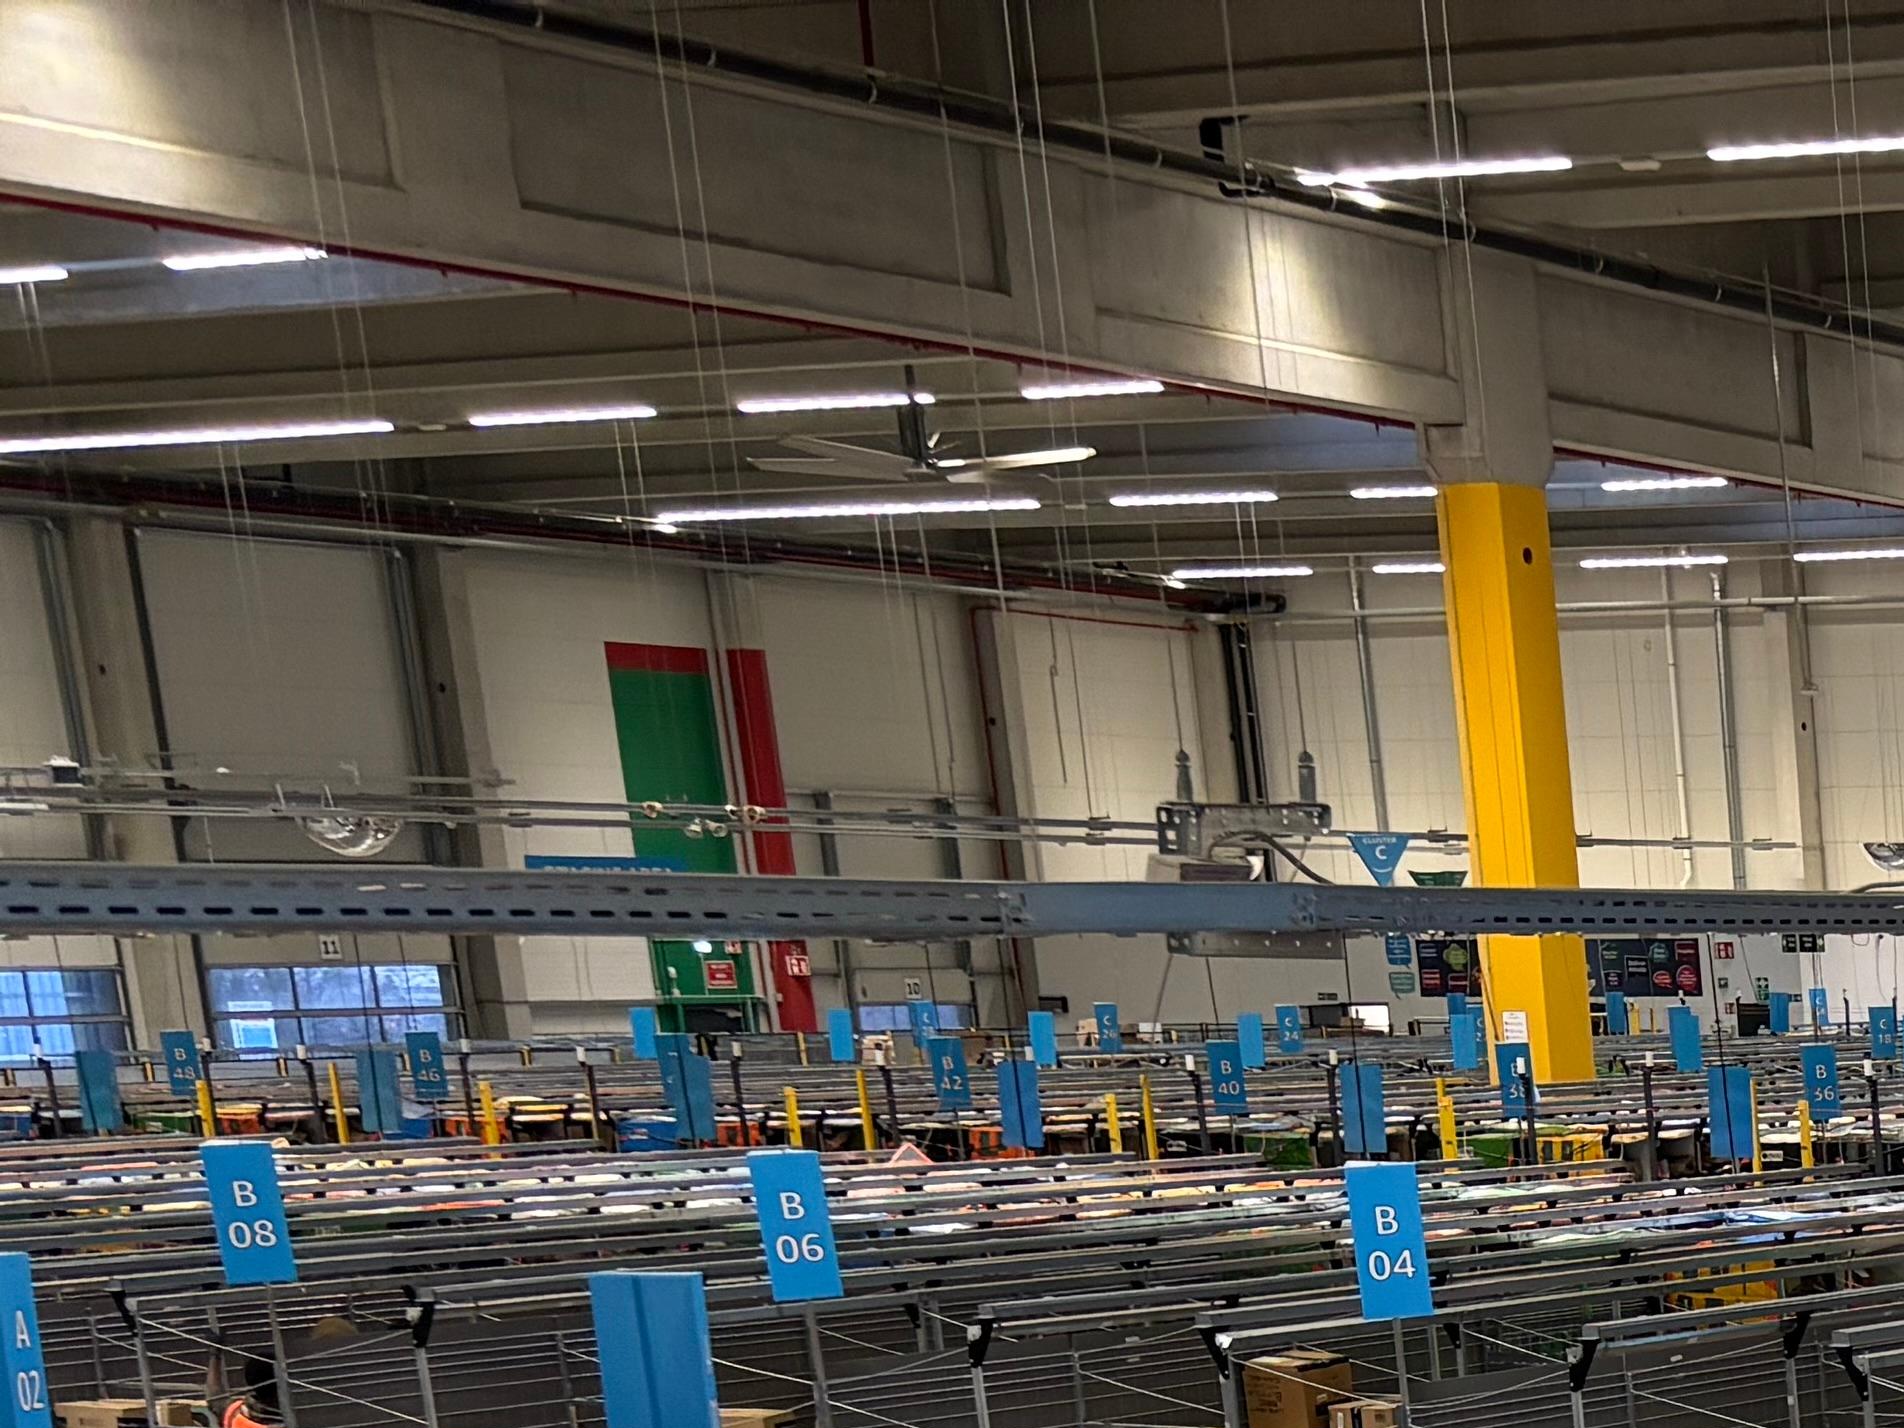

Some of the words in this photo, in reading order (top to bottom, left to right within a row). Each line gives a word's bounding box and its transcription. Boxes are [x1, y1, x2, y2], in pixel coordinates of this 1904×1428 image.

[1375, 845, 1388, 860] C
[322, 940, 340, 955] 11
[906, 982, 921, 996] 10
[174, 1048, 186, 1061] B
[419, 1049, 432, 1063] B
[941, 1056, 954, 1070] B
[1220, 1059, 1232, 1075] B
[173, 1066, 196, 1080] 48
[416, 1068, 440, 1082] 46
[1815, 1064, 1827, 1079] B
[940, 1075, 964, 1091] 42
[1217, 1080, 1240, 1096] 40
[1813, 1085, 1835, 1102] 36
[232, 1179, 257, 1207] B
[779, 1191, 806, 1220] B
[1374, 1205, 1400, 1236] B
[227, 1220, 278, 1249] 08
[774, 1233, 825, 1264] 06
[1367, 1249, 1417, 1281] 04
[14, 1310, 31, 1350] A
[16, 1370, 46, 1412] 02
